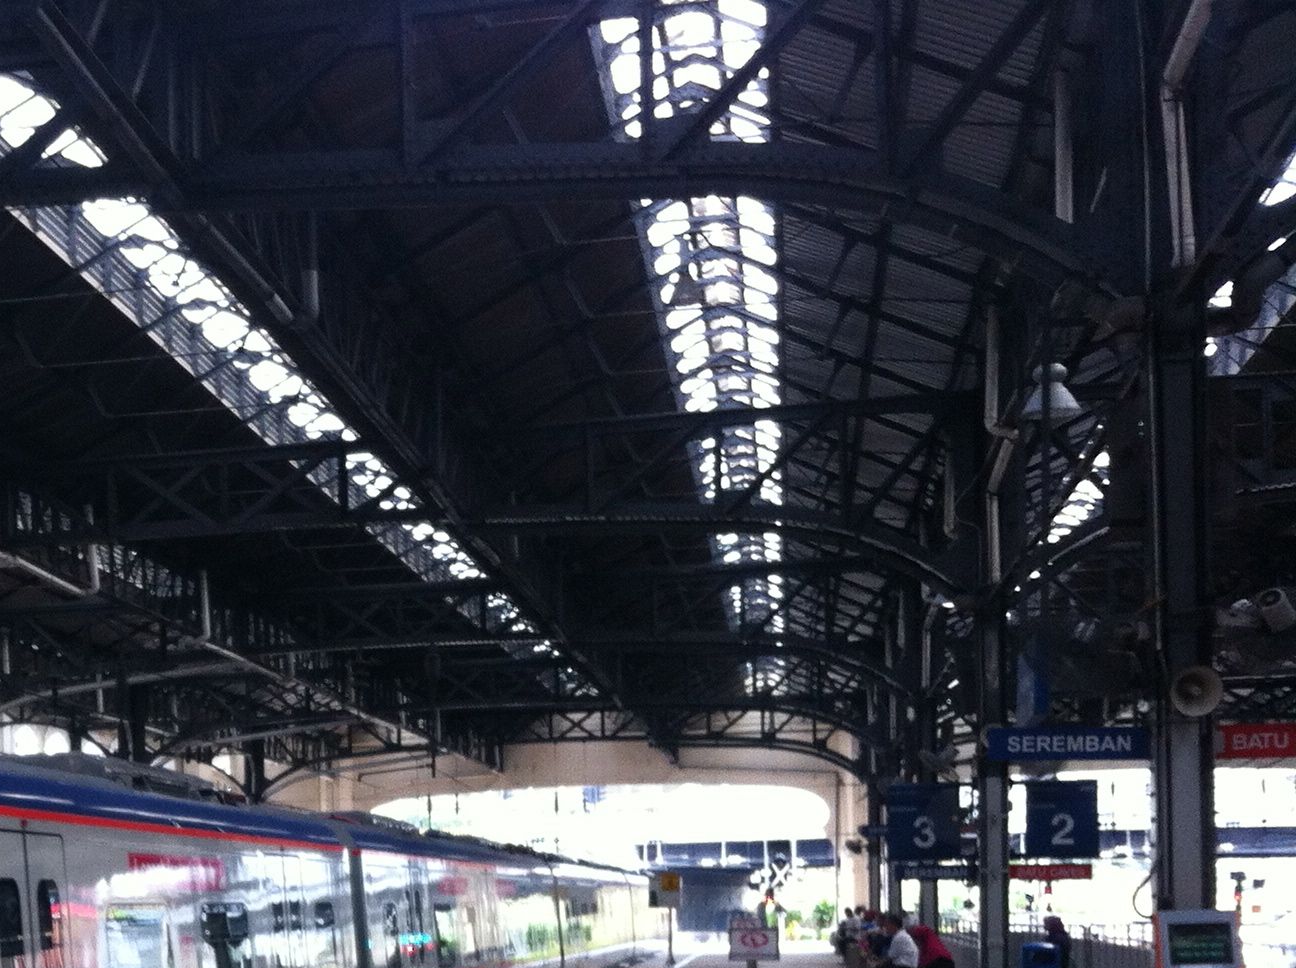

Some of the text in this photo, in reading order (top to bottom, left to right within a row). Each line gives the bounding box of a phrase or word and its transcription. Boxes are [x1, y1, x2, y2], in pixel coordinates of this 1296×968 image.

[1007, 734, 1132, 753] SEREMBAN
[1232, 732, 1291, 751] BATU
[912, 815, 937, 849] 3
[1050, 812, 1076, 846] 2
